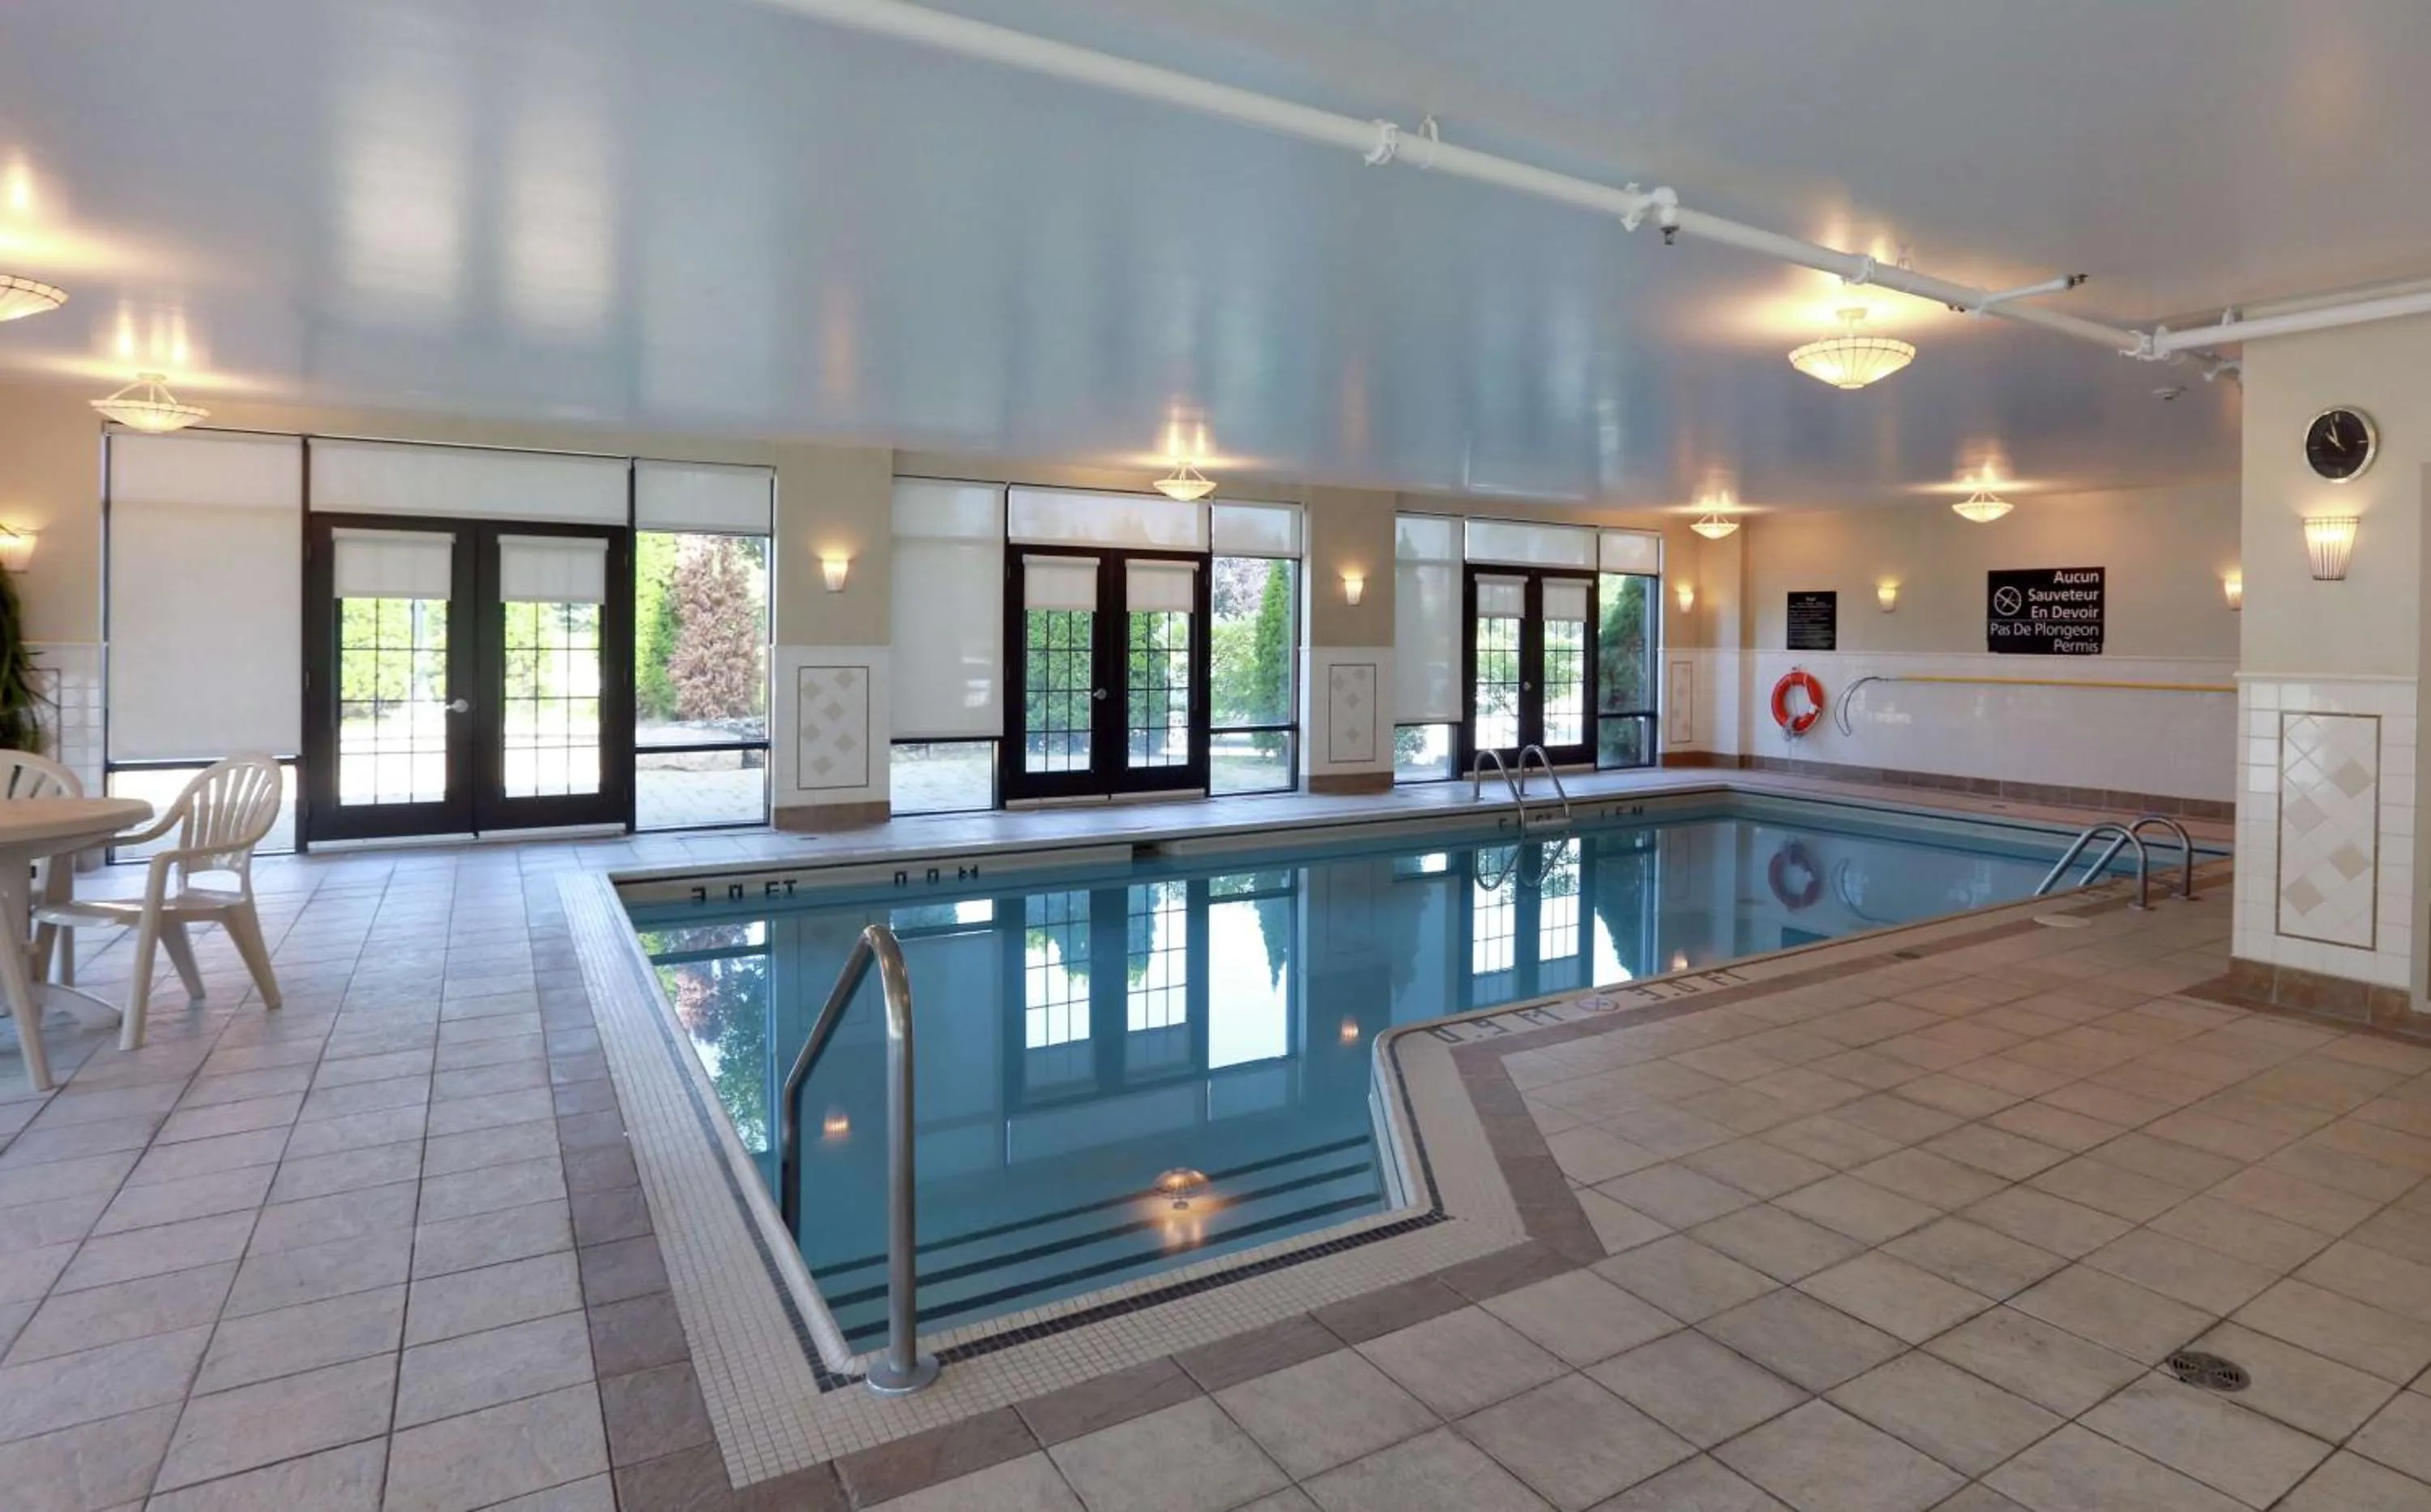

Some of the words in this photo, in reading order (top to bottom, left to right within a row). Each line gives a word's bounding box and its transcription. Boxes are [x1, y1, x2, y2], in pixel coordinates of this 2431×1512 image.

[2053, 570, 2099, 583] Aucun
[2028, 588, 2099, 602] Sauveteur
[2032, 605, 2048, 618] En
[2052, 604, 2099, 618] Devoir
[1990, 622, 2010, 635] Pas
[2014, 622, 2032, 635] De
[2035, 622, 2099, 639] Plongeon
[2053, 639, 2099, 652] Permis
